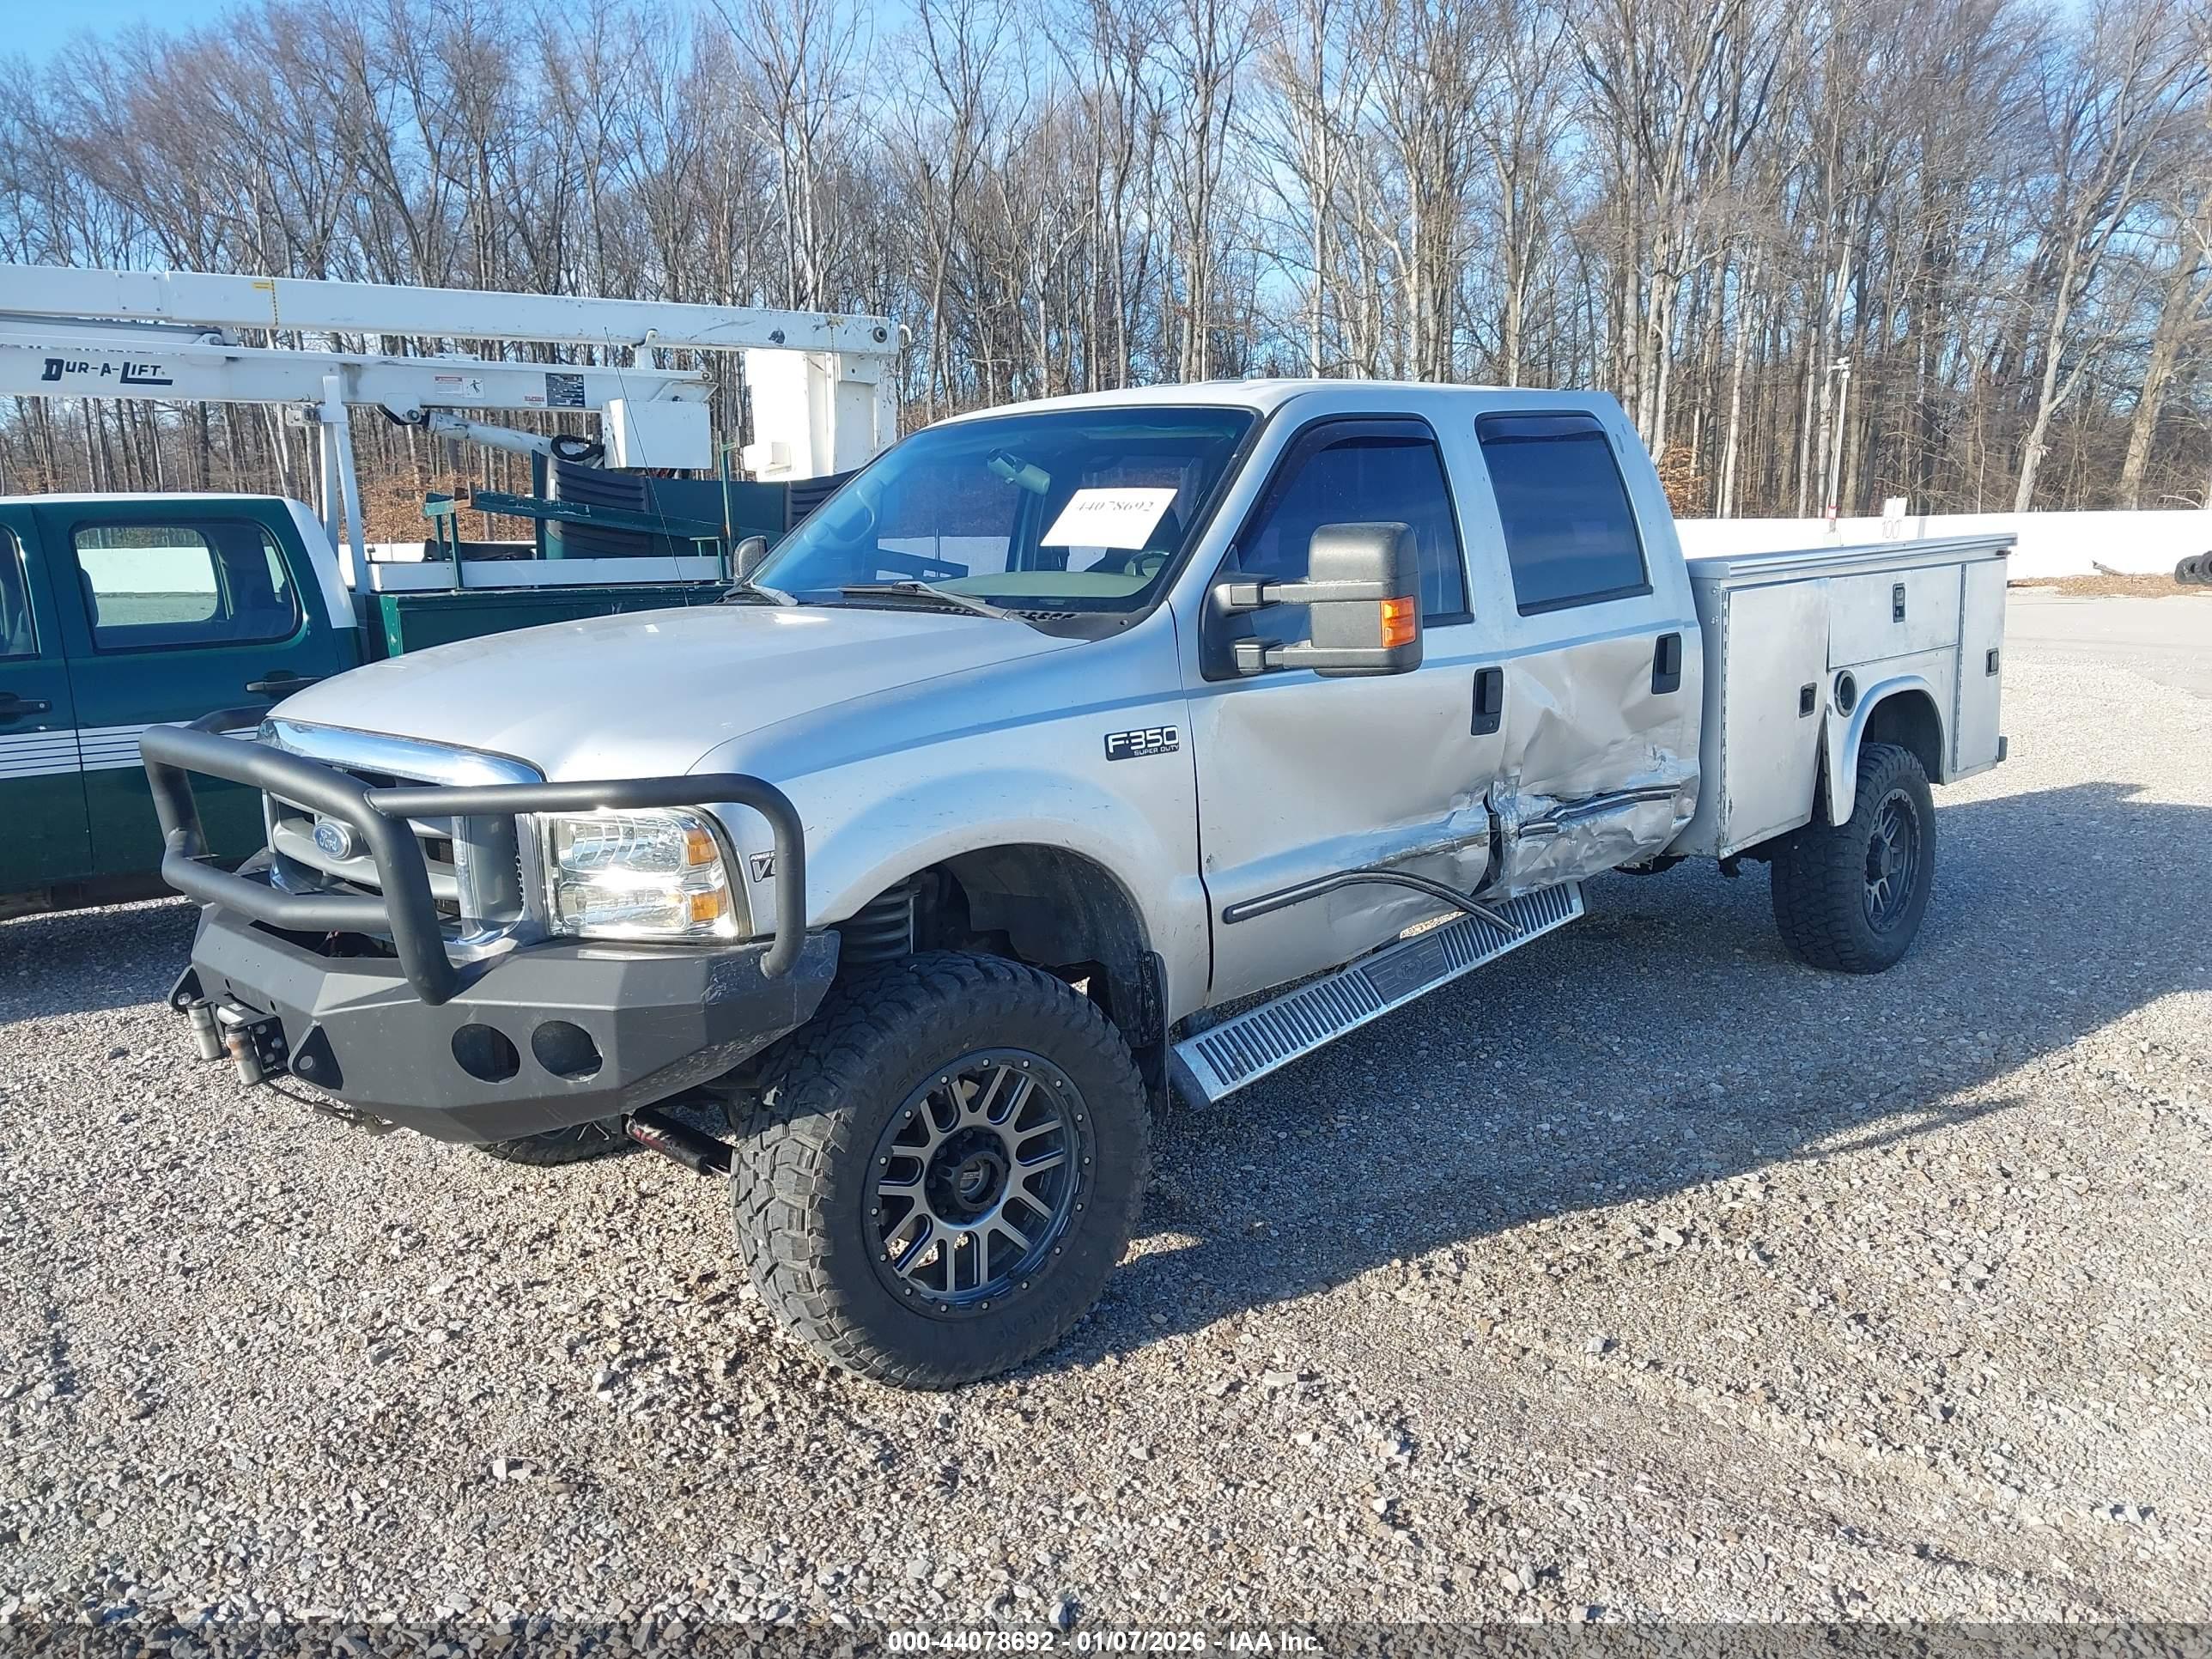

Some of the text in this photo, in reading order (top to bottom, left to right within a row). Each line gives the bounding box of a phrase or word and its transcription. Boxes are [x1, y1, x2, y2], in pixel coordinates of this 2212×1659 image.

[41, 358, 173, 386] DUR-A-LIFT
[1077, 501, 1154, 513] 44078692
[319, 829, 337, 852] Ford
